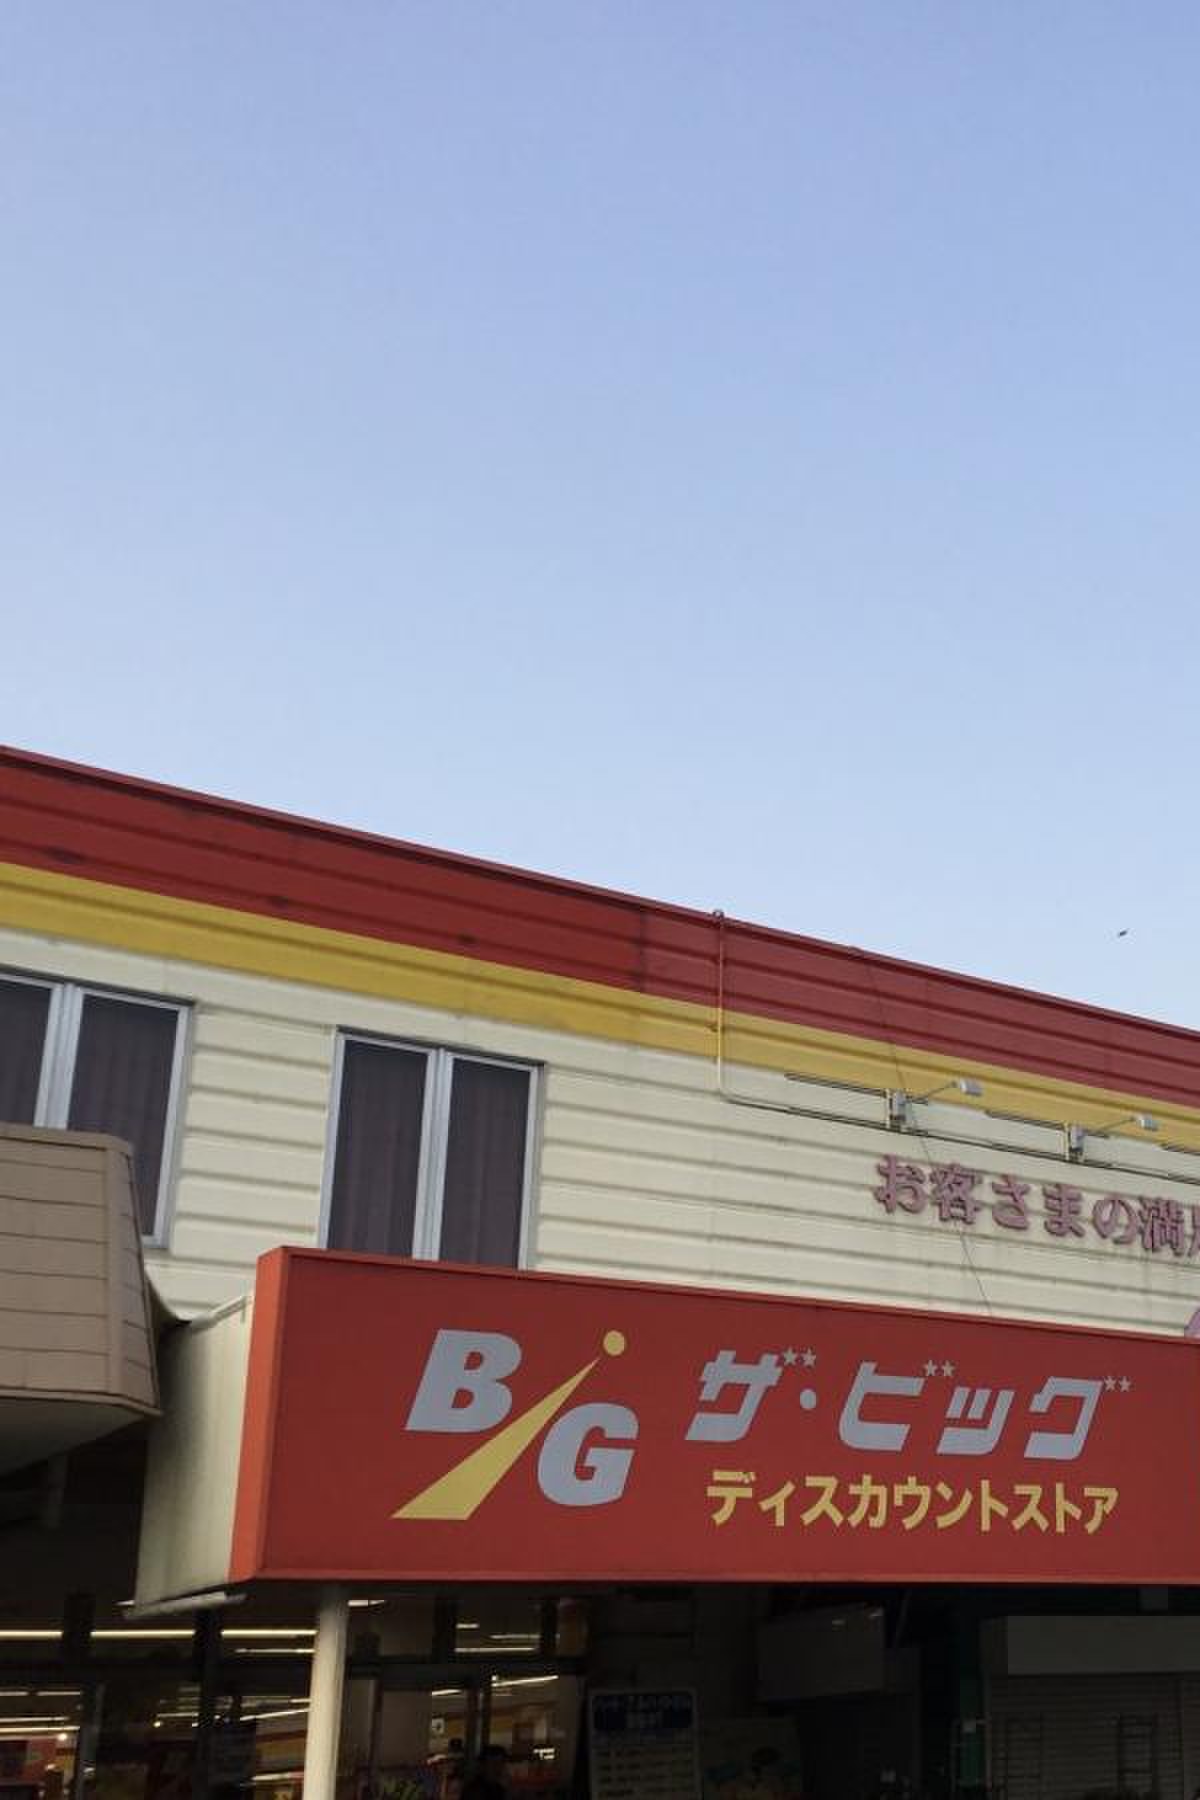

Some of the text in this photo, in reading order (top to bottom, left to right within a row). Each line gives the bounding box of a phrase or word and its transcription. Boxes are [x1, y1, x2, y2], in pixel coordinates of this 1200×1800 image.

[706, 1469, 1120, 1535] ディスカウントストア
